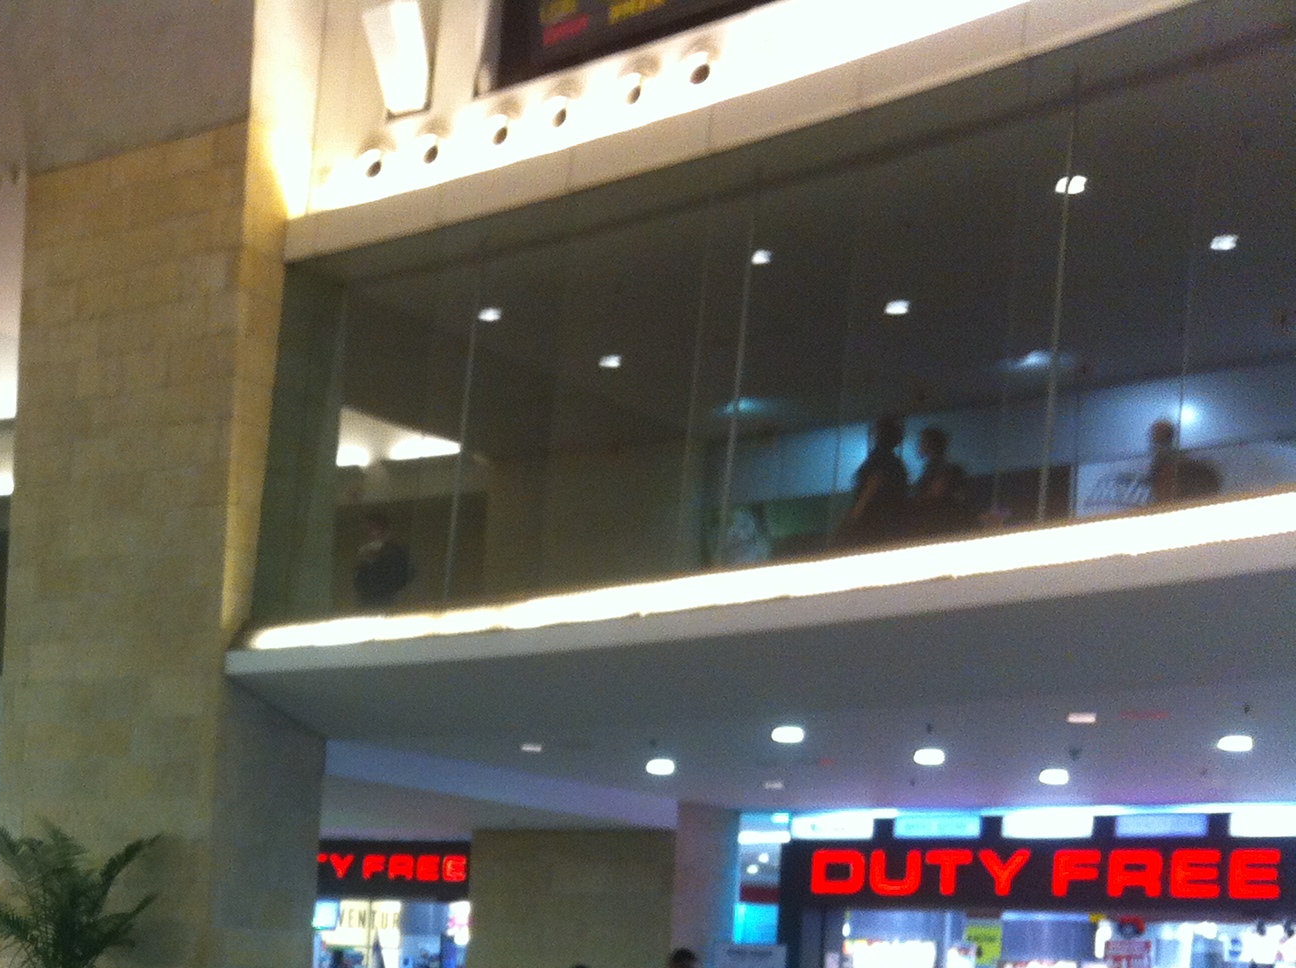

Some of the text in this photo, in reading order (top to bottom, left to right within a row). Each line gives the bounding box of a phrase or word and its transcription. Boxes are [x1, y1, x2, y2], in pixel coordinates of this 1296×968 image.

[363, 853, 467, 882] FREE
[811, 848, 1281, 900] DUTY FREE
